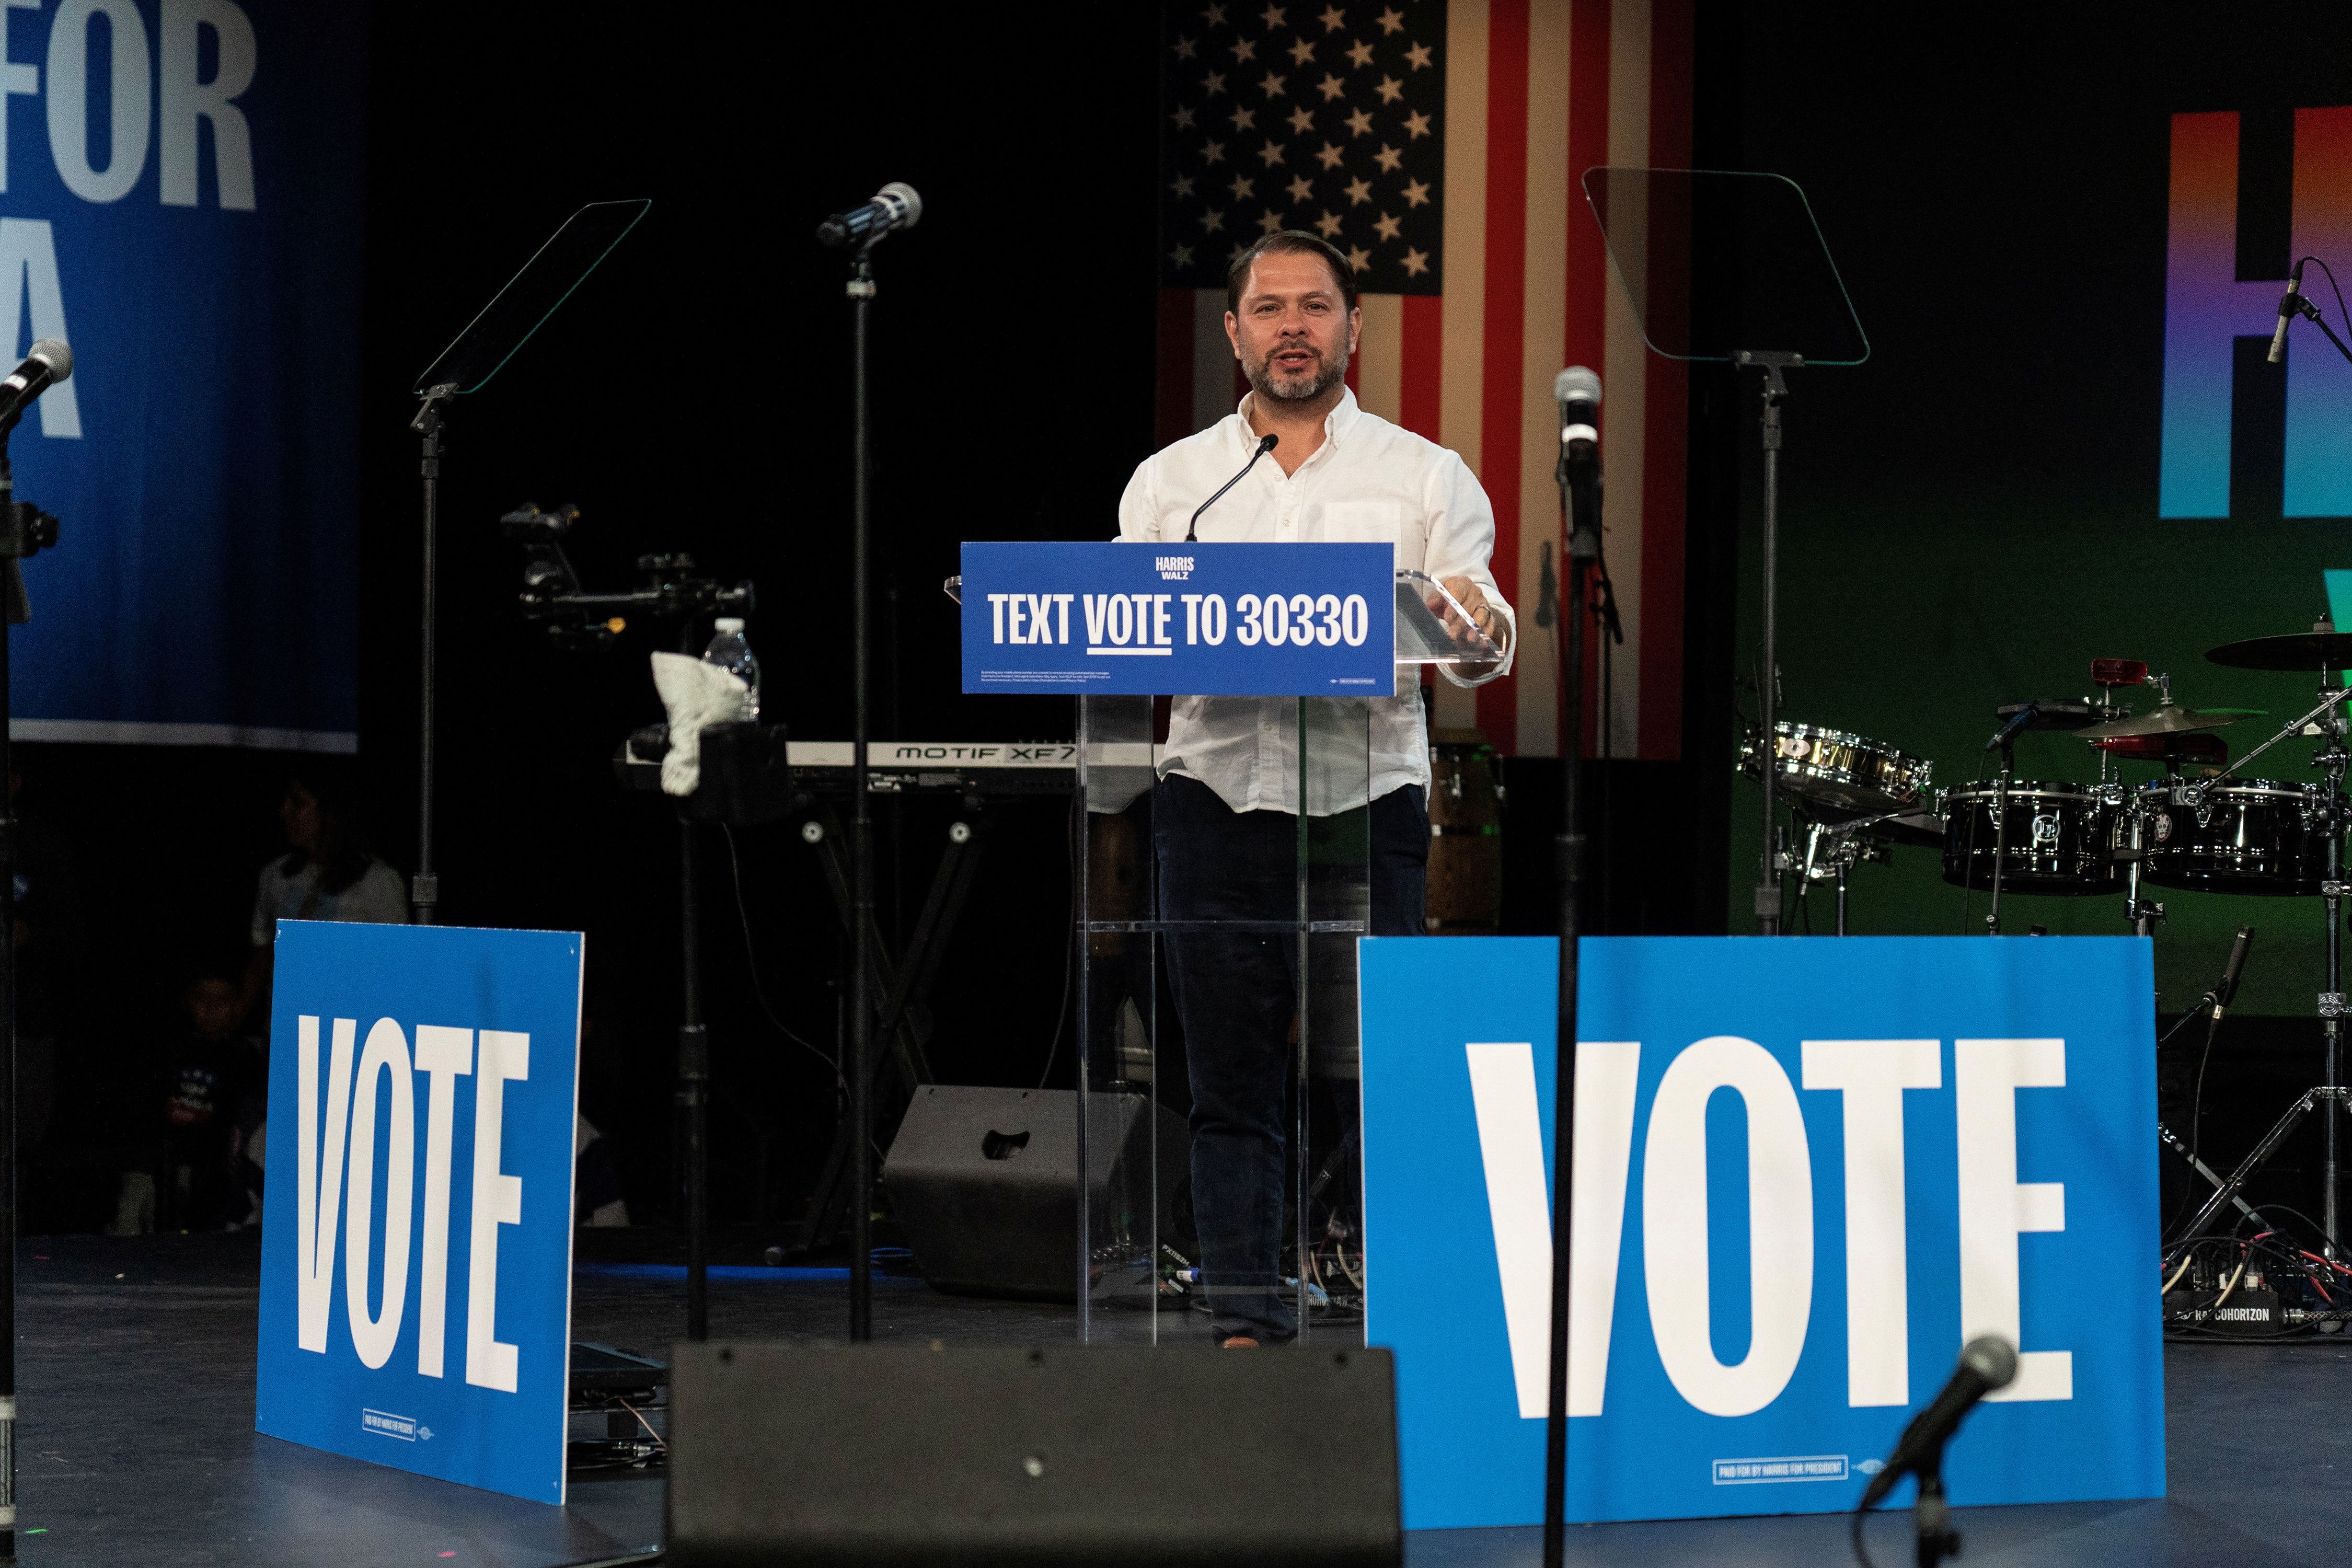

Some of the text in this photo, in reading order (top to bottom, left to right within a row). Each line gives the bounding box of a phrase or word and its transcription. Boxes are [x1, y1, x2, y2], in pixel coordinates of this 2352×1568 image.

[1155, 557, 1194, 572] HARRIS
[1161, 571, 1189, 580] WALZ
[987, 594, 1368, 647] TEXT VOTE TO 30330
[895, 746, 1076, 760] MOTIF XF7
[298, 1015, 530, 1394] VOTE
[1465, 1035, 2073, 1420] VOTE
